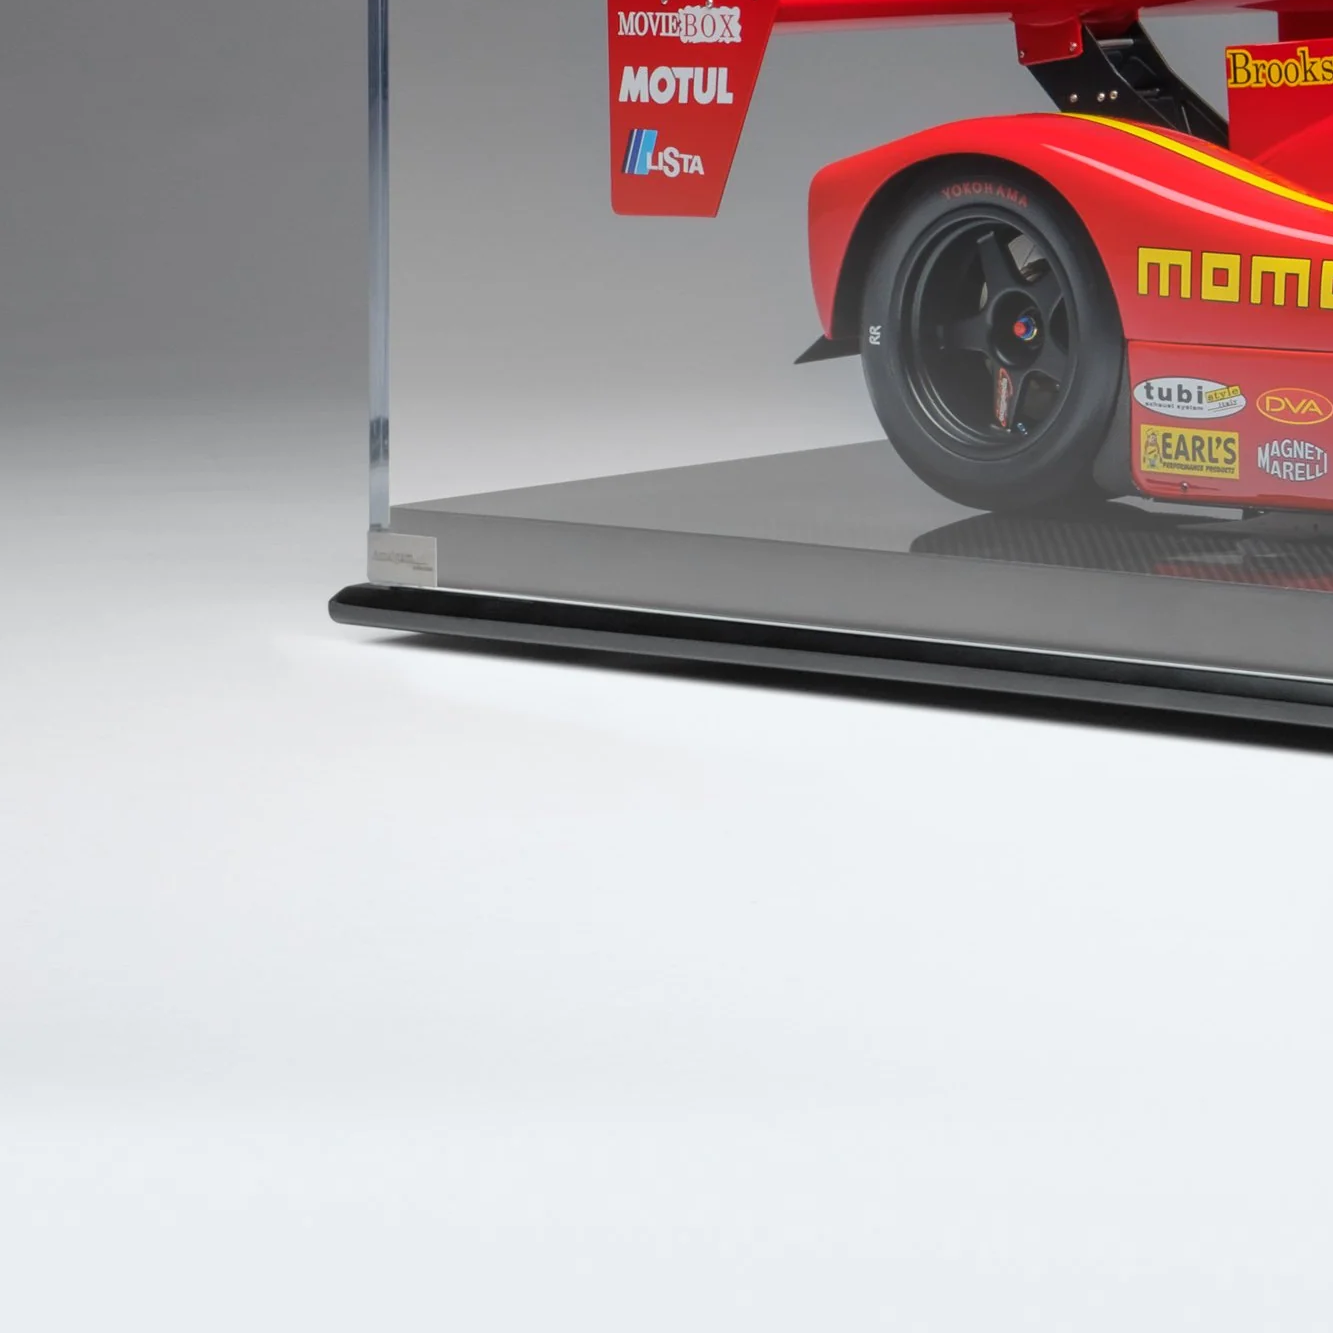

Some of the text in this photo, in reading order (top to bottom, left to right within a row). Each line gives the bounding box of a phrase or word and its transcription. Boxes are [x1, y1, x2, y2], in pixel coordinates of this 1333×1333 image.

[618, 65, 734, 104] MOTUL
[940, 181, 1030, 208] YOKOHAMA
[1143, 381, 1204, 405] tubi
[1264, 395, 1324, 416] DVA
[1161, 432, 1237, 465] EARL'S
[1162, 462, 1236, 474] PERFORMANCE PRODUCTS
